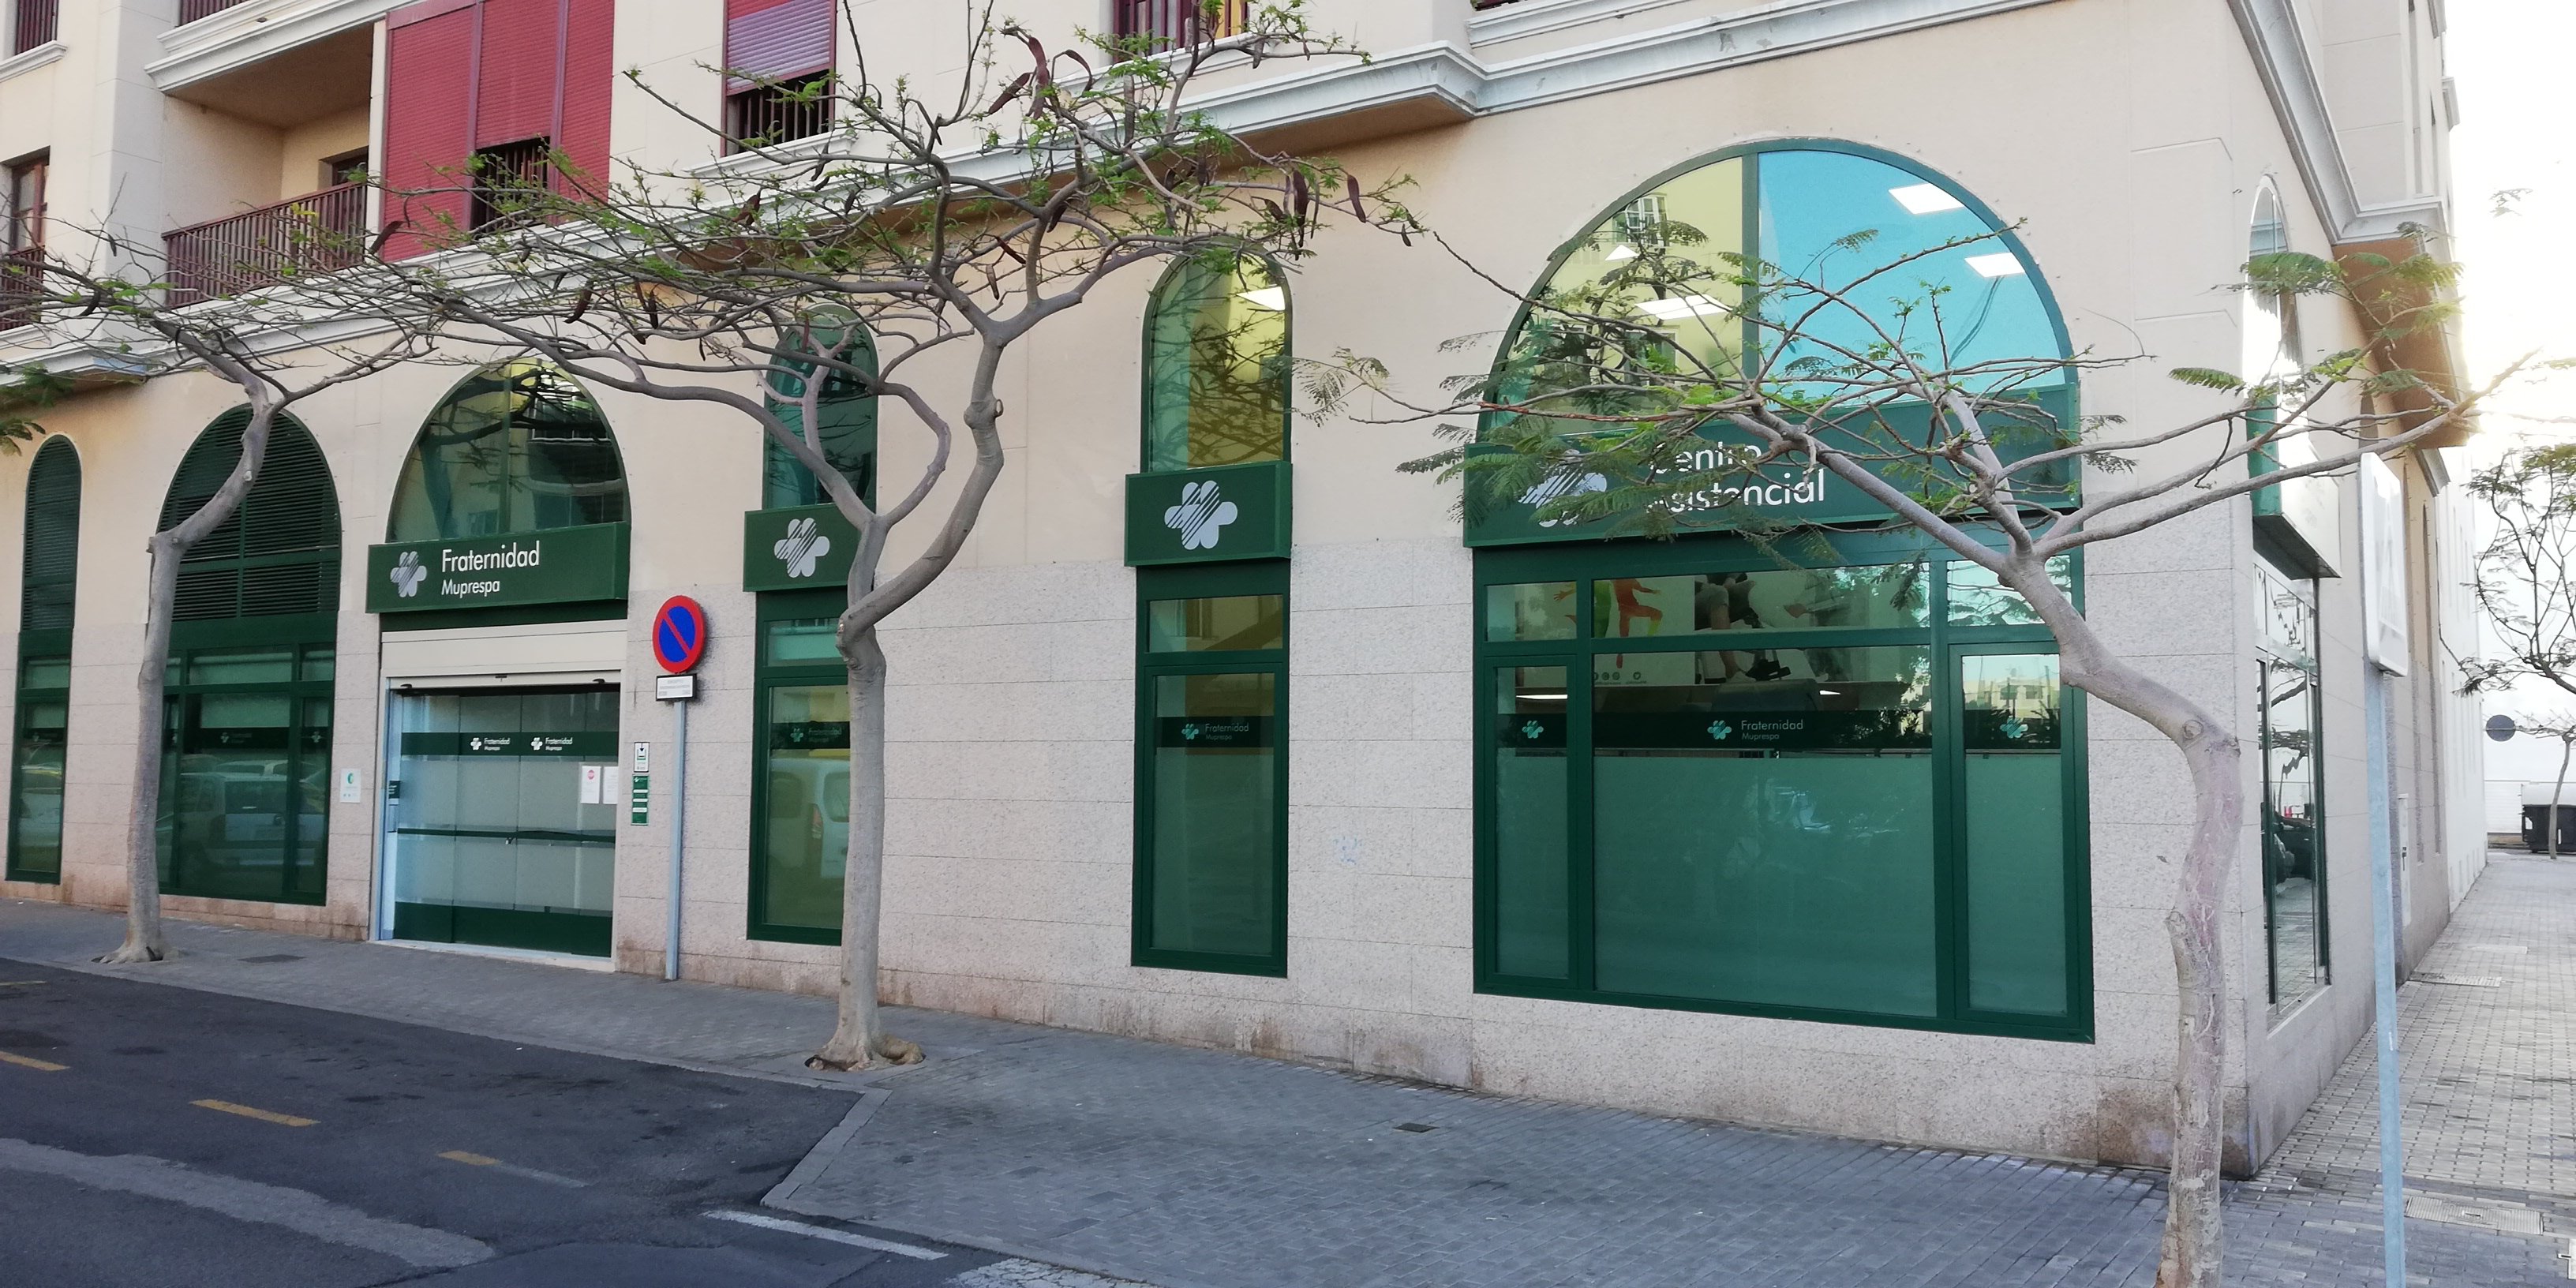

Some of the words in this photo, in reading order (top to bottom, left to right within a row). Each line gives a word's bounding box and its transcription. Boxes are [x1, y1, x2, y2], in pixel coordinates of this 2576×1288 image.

[1646, 468, 1825, 514] sistncial
[442, 540, 540, 572] Fraternidad
[441, 578, 500, 598] Muprespa
[1205, 723, 1249, 732] Fraternidad
[1741, 719, 1803, 731] Fraternidad
[1742, 732, 1780, 741] Muprespa
